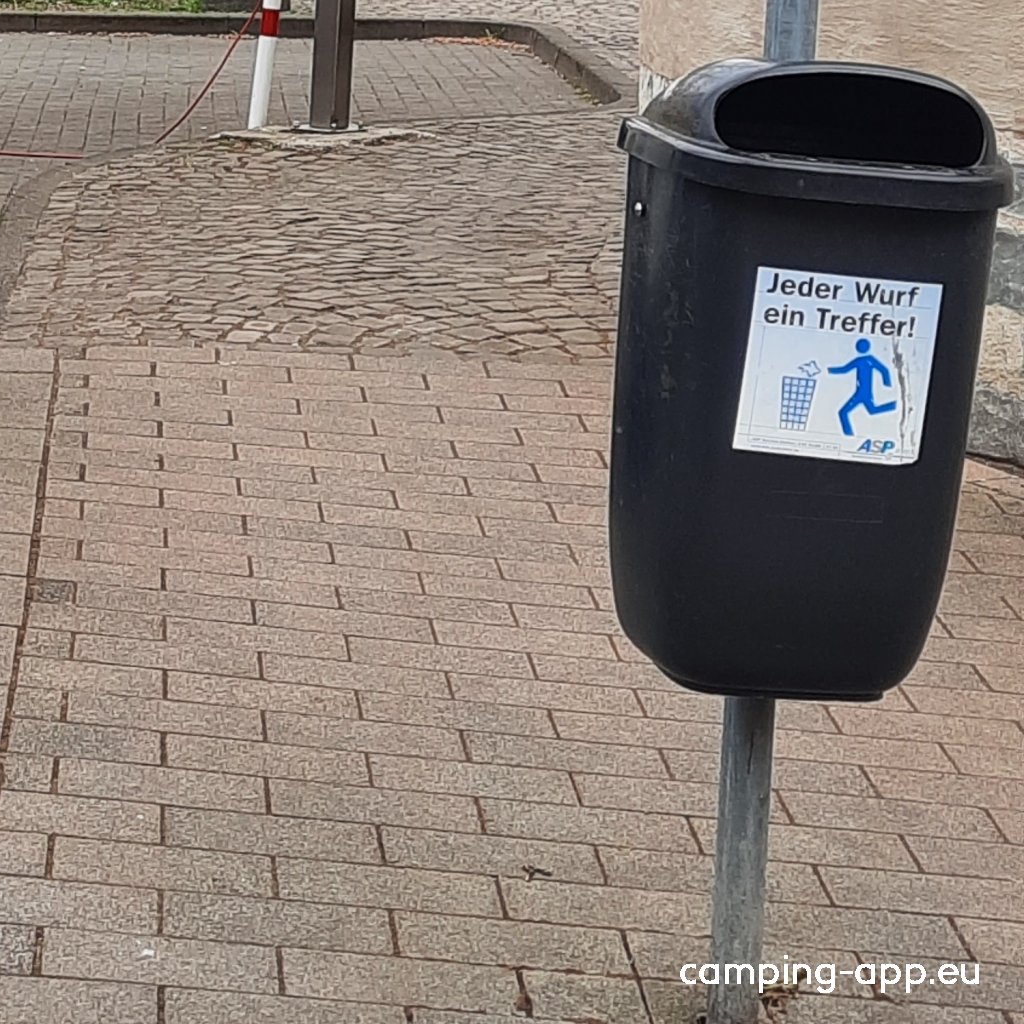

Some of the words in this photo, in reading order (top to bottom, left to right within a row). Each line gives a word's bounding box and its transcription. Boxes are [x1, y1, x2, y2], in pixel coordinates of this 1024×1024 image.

[766, 273, 843, 300] Jeder
[855, 281, 920, 307] Wurf
[763, 304, 805, 327] ein
[816, 307, 916, 338] Treffer!
[857, 438, 895, 453] ASP
